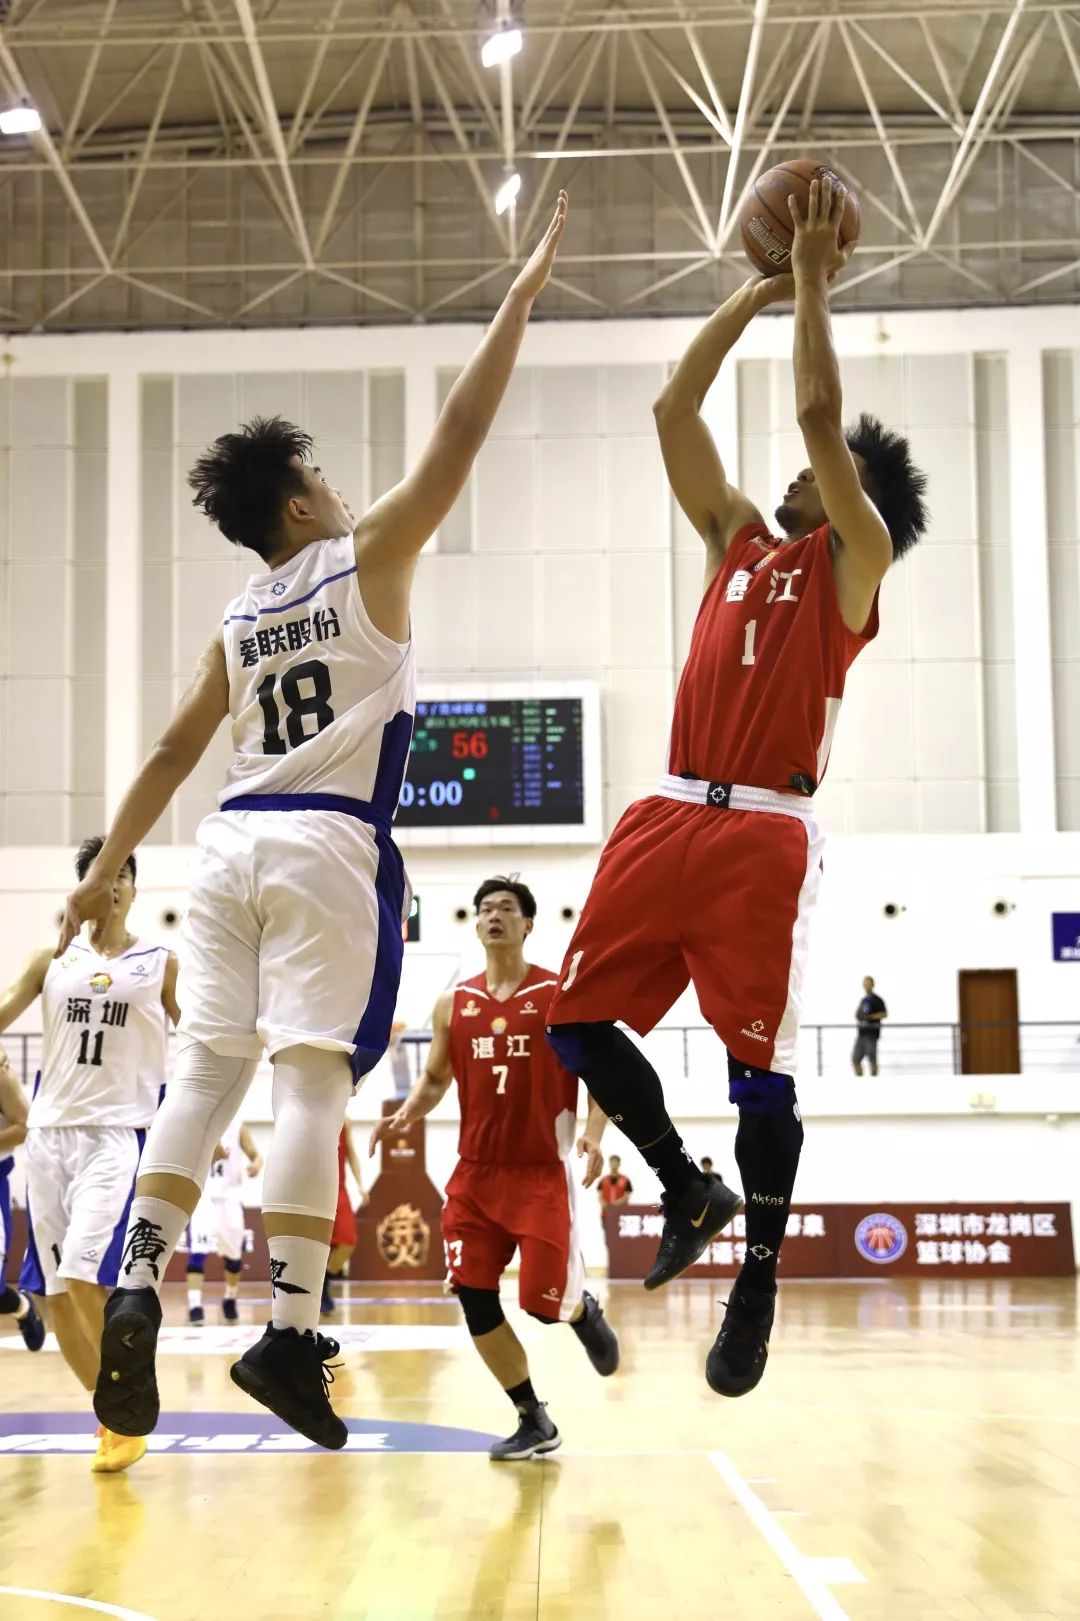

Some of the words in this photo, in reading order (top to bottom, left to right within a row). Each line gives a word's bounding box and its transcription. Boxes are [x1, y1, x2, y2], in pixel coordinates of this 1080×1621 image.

[240, 607, 341, 668] 爱联股份
[741, 619, 757, 666] 1
[256, 659, 335, 755] 18
[452, 731, 488, 759] 56
[561, 950, 584, 991] 1
[67, 998, 129, 1027] 深圳
[77, 1029, 104, 1066] 11
[471, 1035, 531, 1059] 湛江
[491, 1064, 509, 1094] 7
[914, 1212, 1058, 1236] 深圳市龙岗区
[915, 1240, 1011, 1265] 篮球协会
